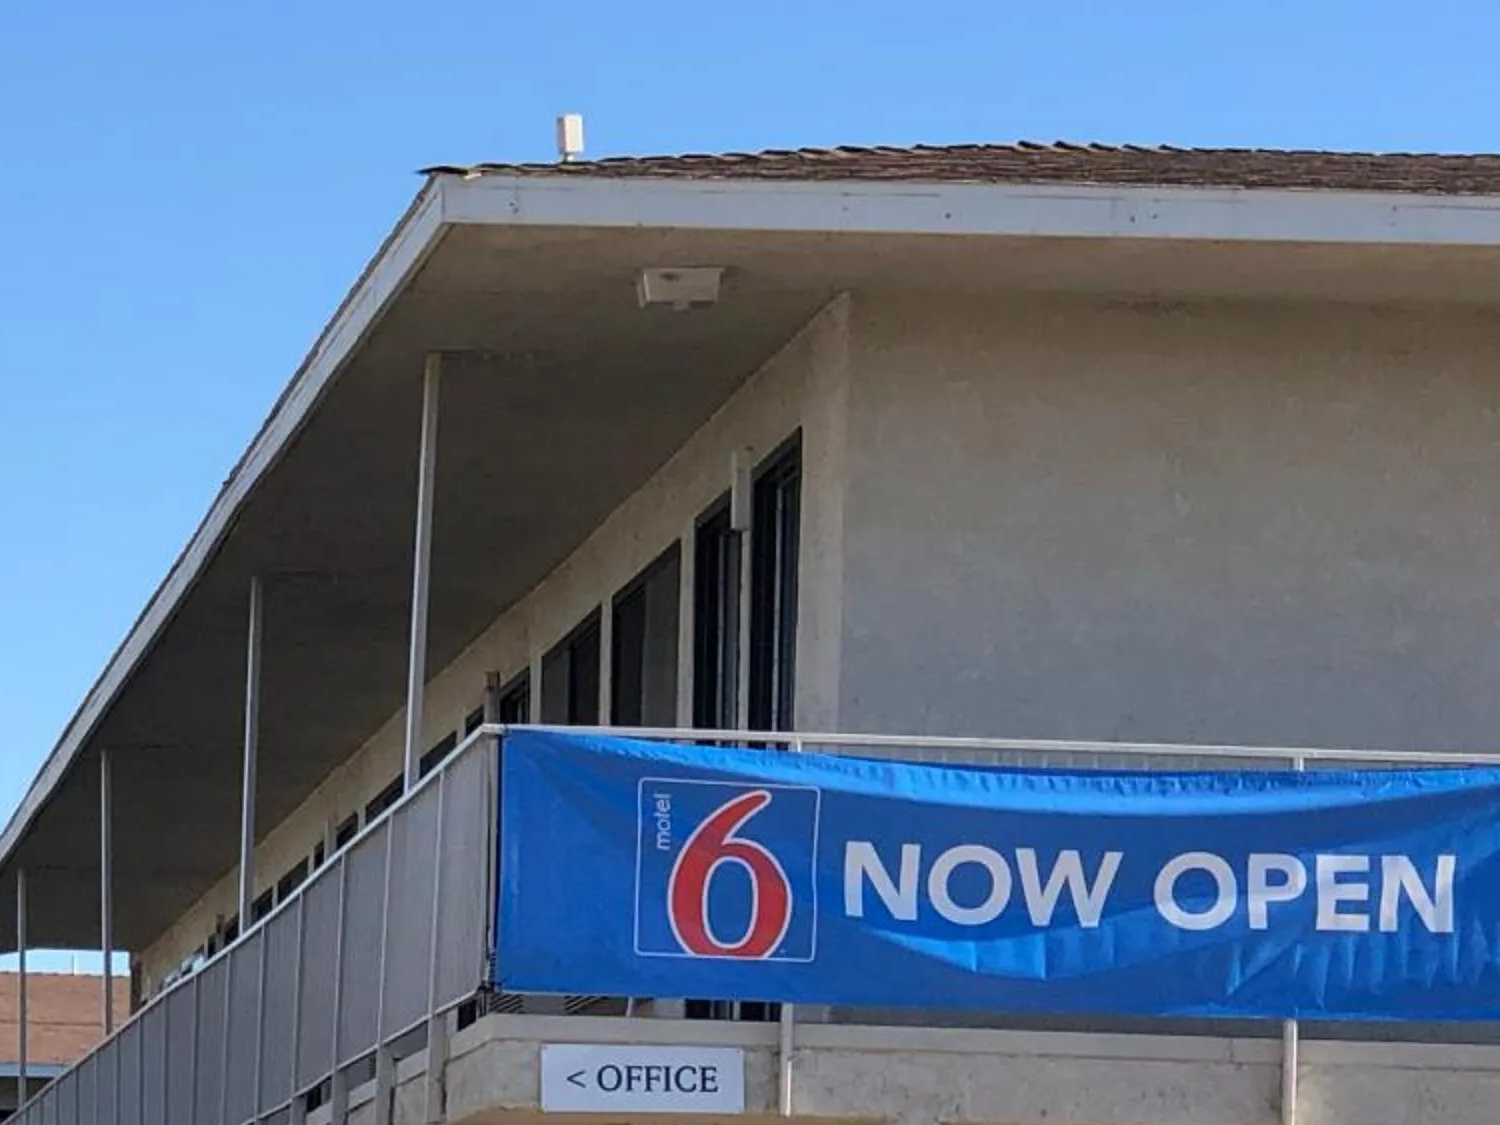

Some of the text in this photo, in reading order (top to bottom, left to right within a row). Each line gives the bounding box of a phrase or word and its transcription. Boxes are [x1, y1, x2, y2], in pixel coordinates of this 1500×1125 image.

[652, 789, 793, 960] motel 6
[844, 840, 1456, 933] NOW OPEN
[596, 1064, 719, 1093] OFFICE
